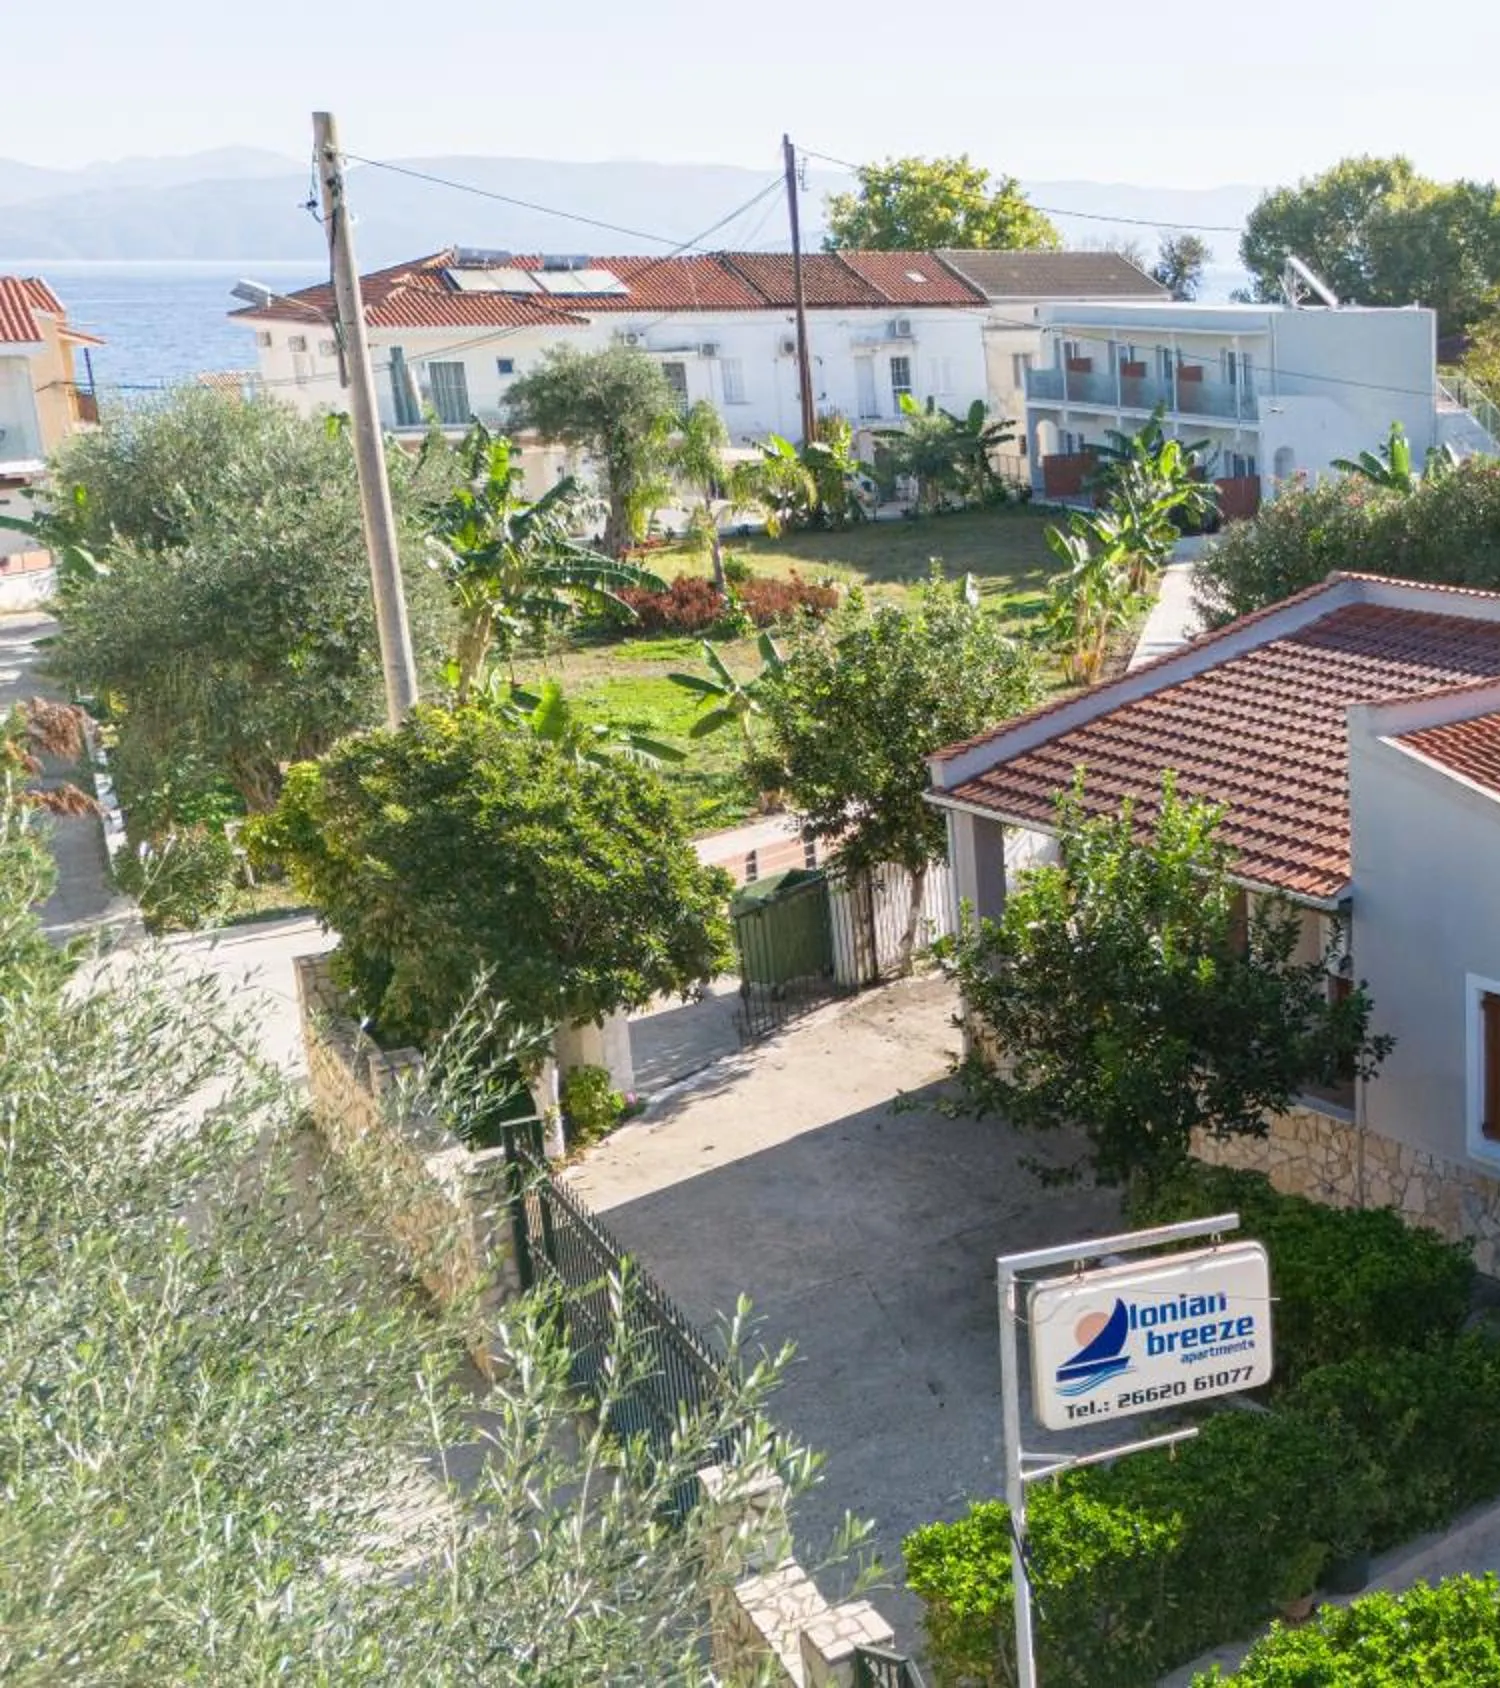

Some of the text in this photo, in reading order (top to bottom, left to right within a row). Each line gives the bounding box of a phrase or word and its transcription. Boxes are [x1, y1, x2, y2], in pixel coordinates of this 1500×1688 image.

[1129, 1292, 1227, 1330] Ionian
[1146, 1315, 1255, 1356] breeze
[1180, 1339, 1255, 1365] apartments
[1064, 1366, 1254, 1420] Tel.: 26620 61077
